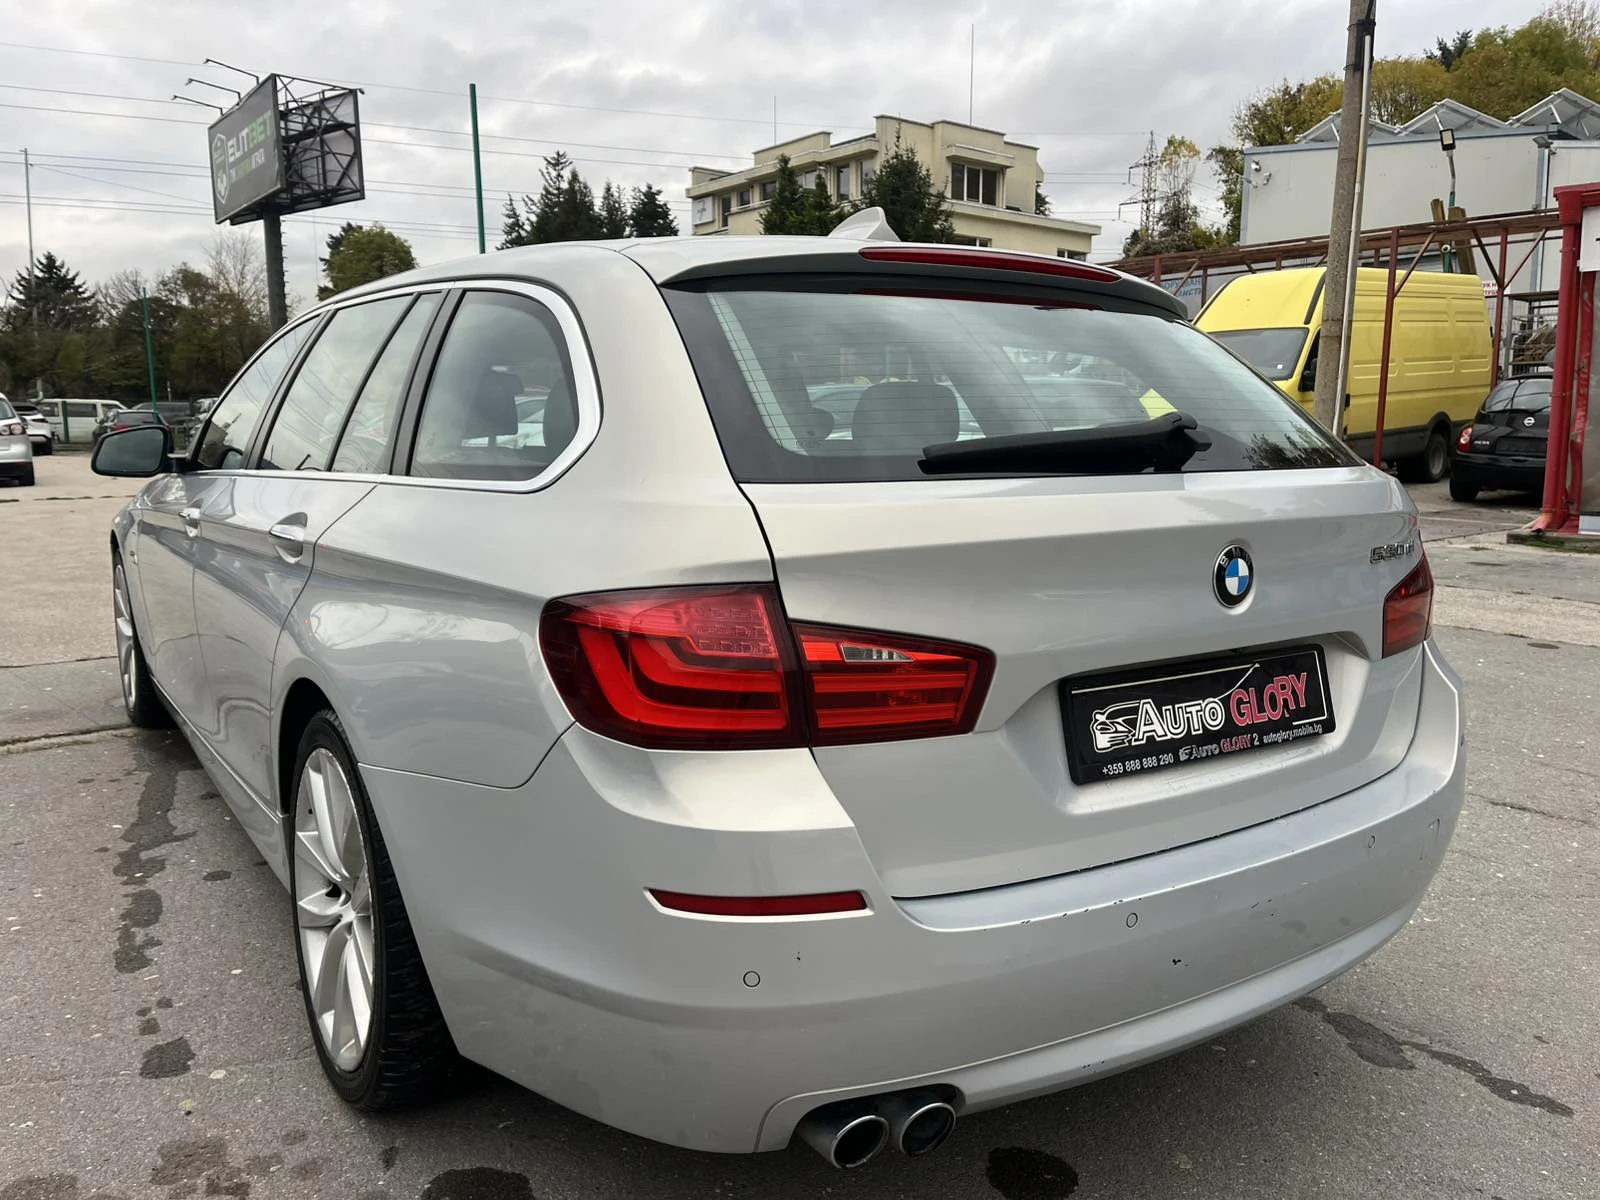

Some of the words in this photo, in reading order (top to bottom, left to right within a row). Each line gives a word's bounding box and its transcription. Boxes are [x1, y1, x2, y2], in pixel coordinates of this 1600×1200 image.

[1230, 673, 1308, 726] GLORY
[1102, 762, 1124, 776] +359
[1125, 759, 1141, 772] 888
[1142, 755, 1158, 769] 888
[1159, 752, 1174, 766] 290
[1220, 734, 1251, 753] GLORY
[1253, 733, 1260, 746] 2
[1263, 723, 1323, 744] autoglory.mobile.bg
